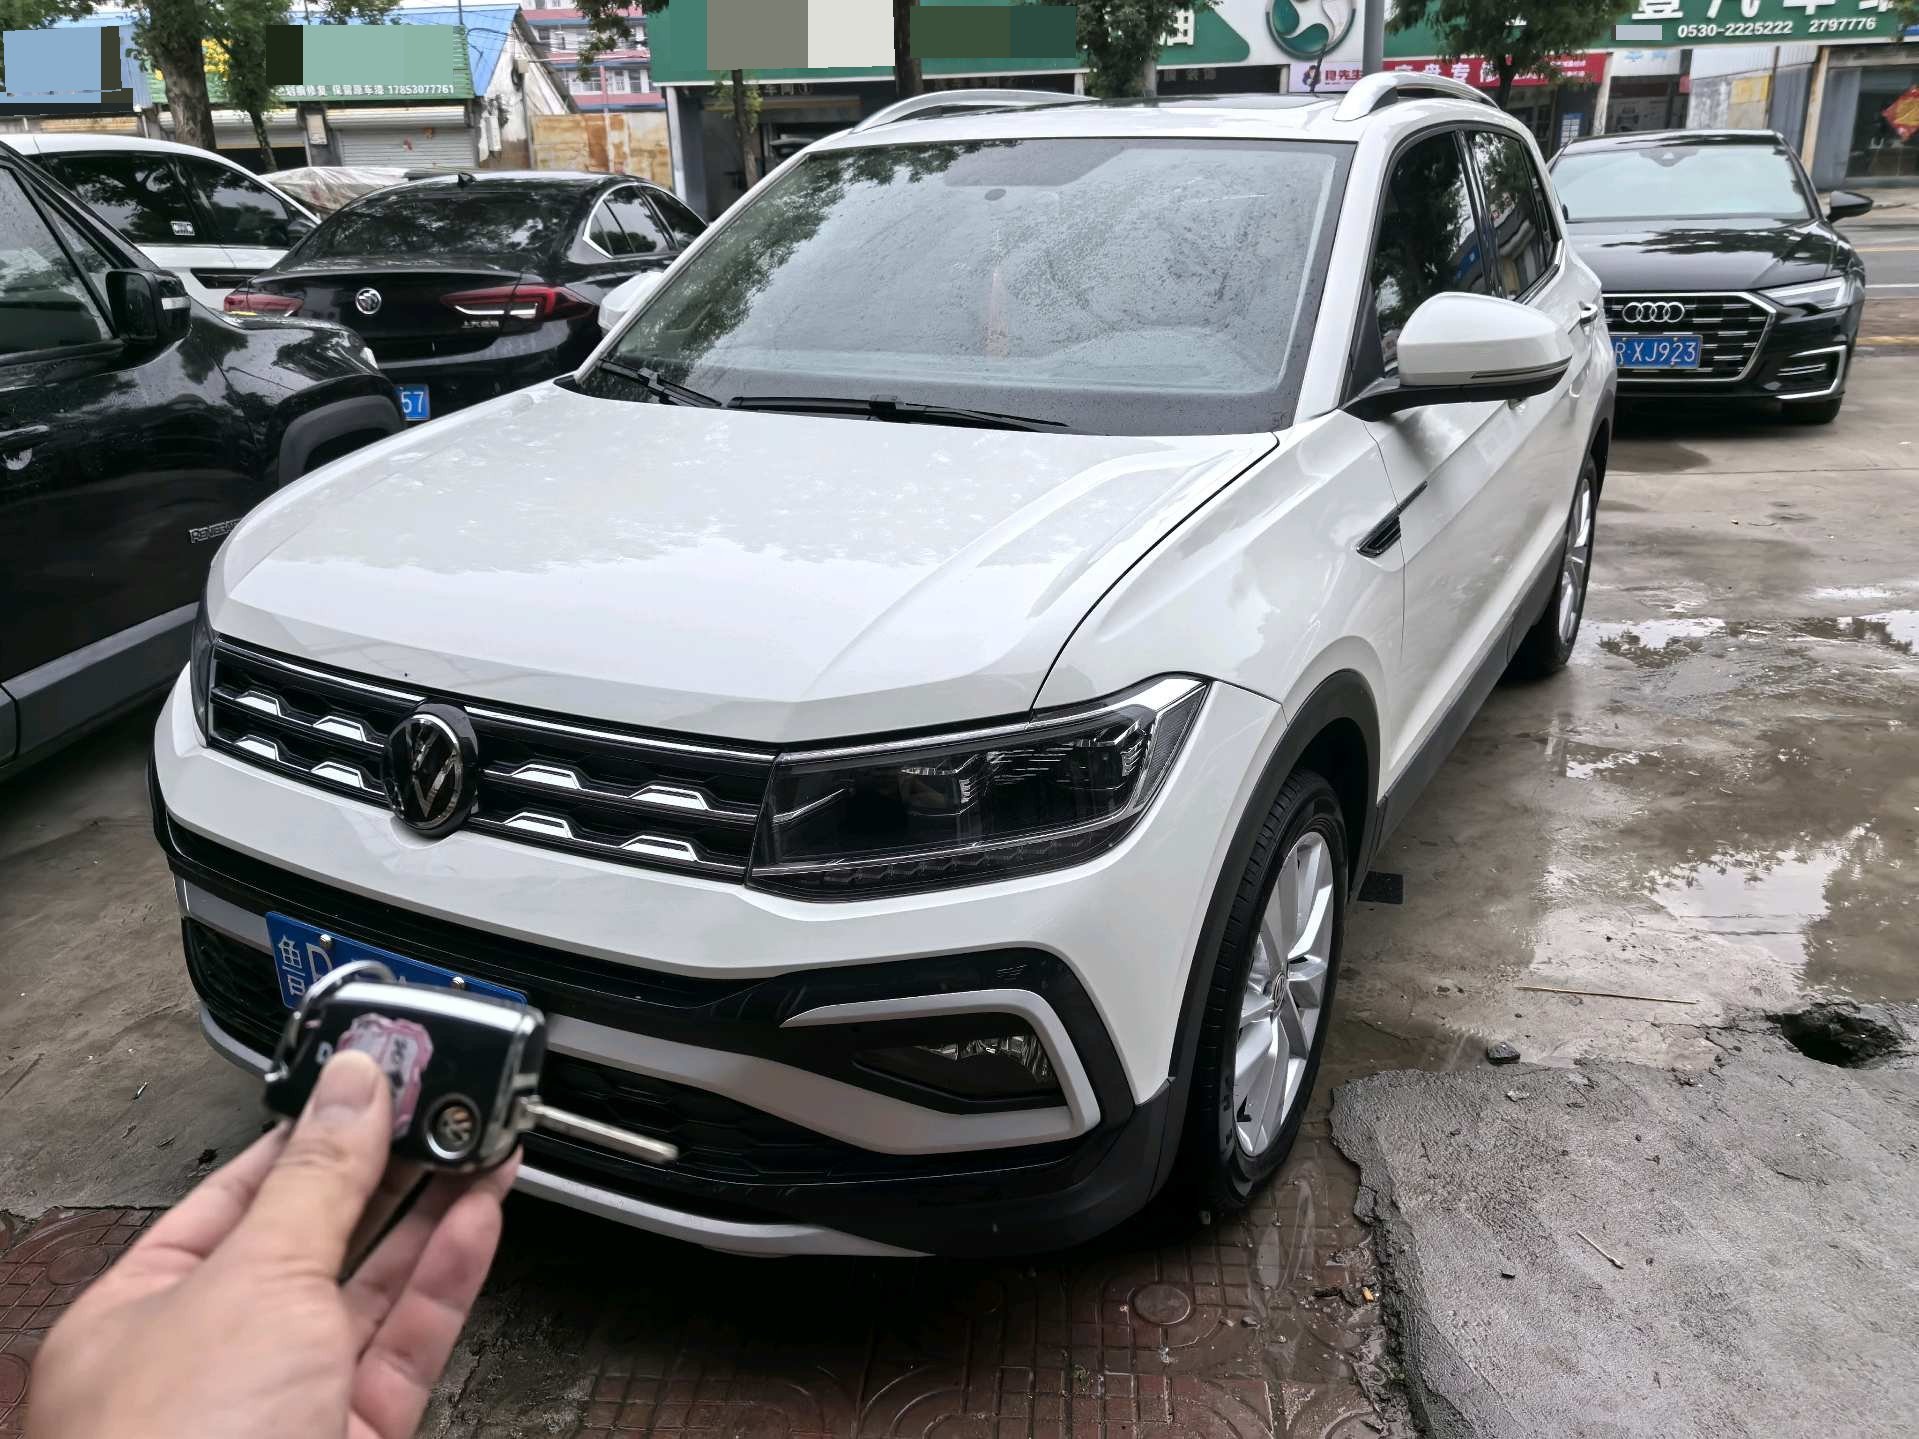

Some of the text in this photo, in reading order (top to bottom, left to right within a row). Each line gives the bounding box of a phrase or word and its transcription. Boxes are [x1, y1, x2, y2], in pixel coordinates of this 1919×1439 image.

[1677, 17, 1877, 38] 0530-2225222 2797776
[387, 84, 455, 95] 17853077761
